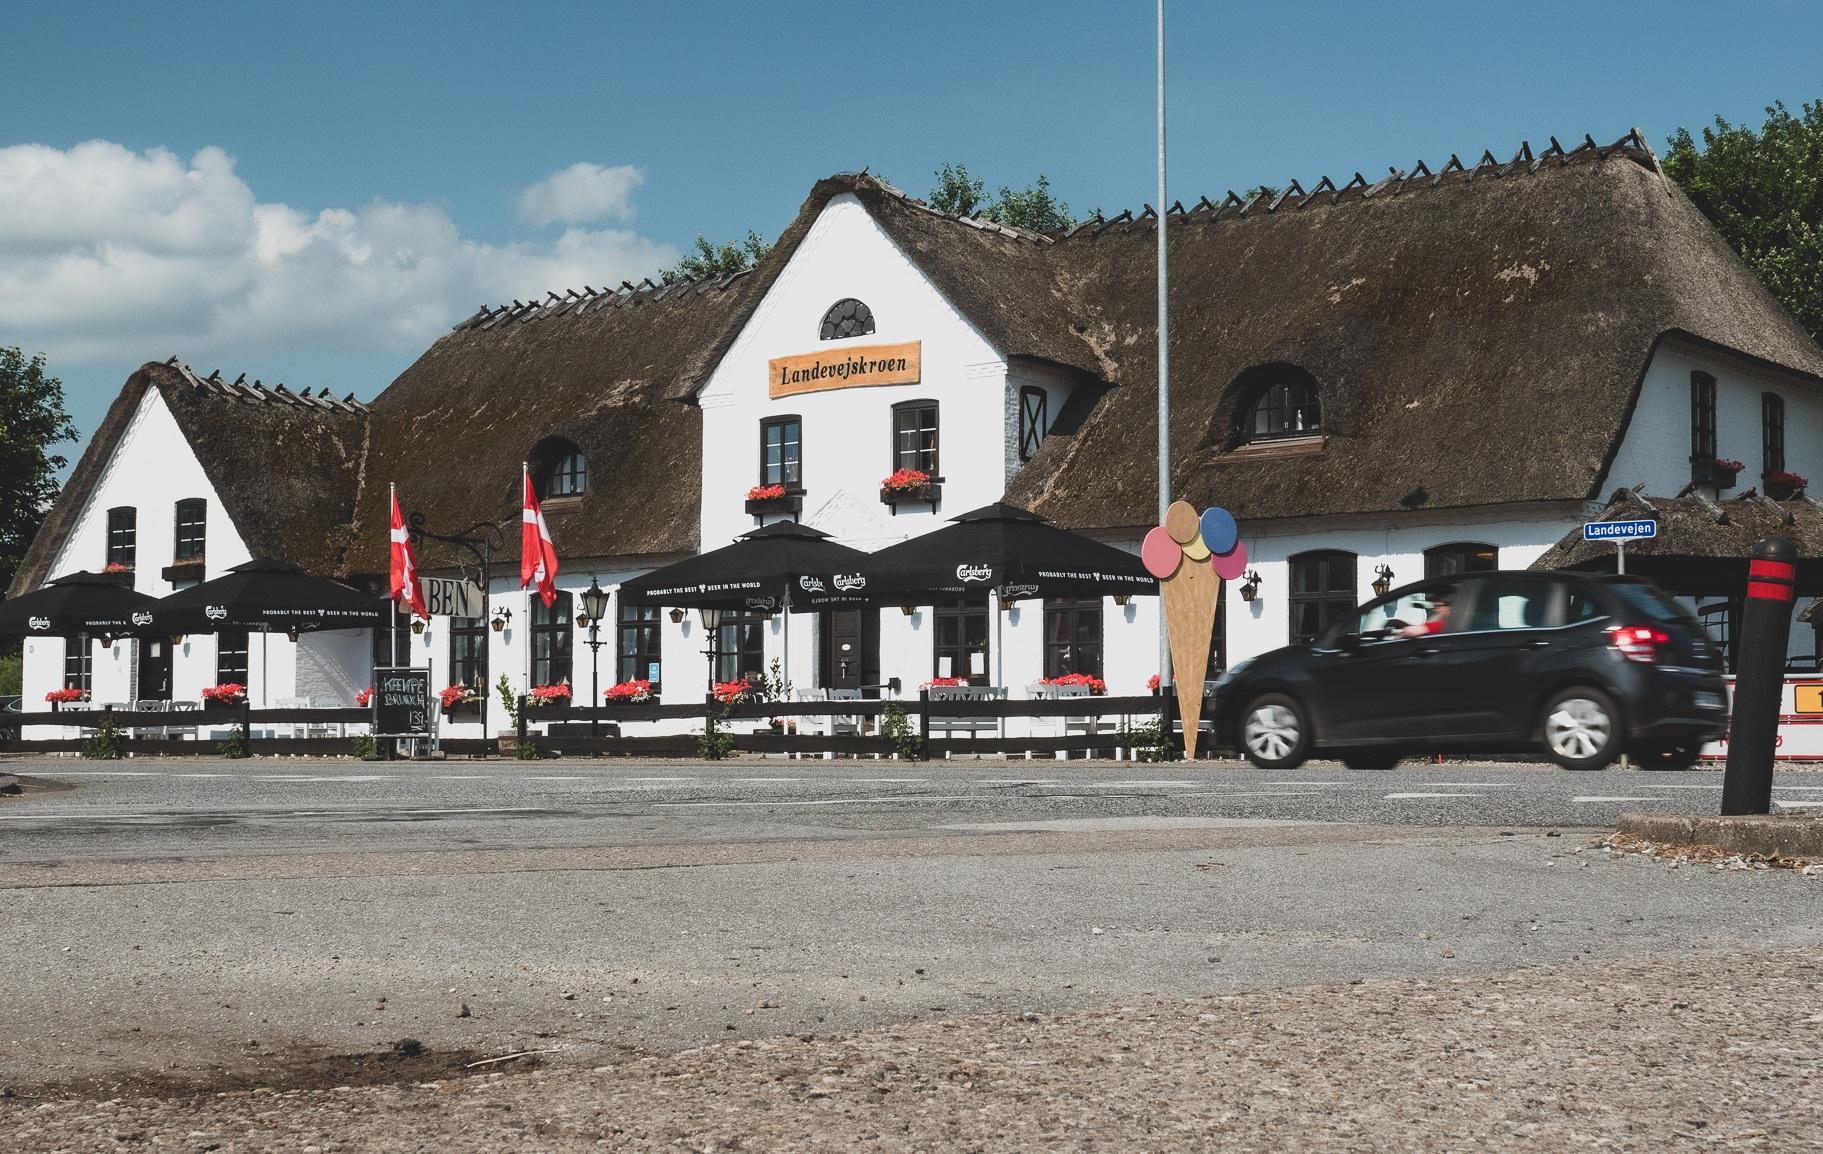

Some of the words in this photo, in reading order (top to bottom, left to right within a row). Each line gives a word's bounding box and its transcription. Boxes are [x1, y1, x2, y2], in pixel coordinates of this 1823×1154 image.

[781, 357, 906, 385] Landevejskroen
[1588, 523, 1652, 536] Landevejen
[956, 564, 992, 582] Carlsberg
[1136, 576, 1154, 584] WORLD
[646, 589, 673, 597] PROBABLY
[729, 582, 741, 590] THE
[741, 581, 761, 589] WORLD
[833, 572, 866, 591] Carlsberg
[205, 605, 227, 619] Carlsberg
[384, 693, 425, 709] BRUNCH
